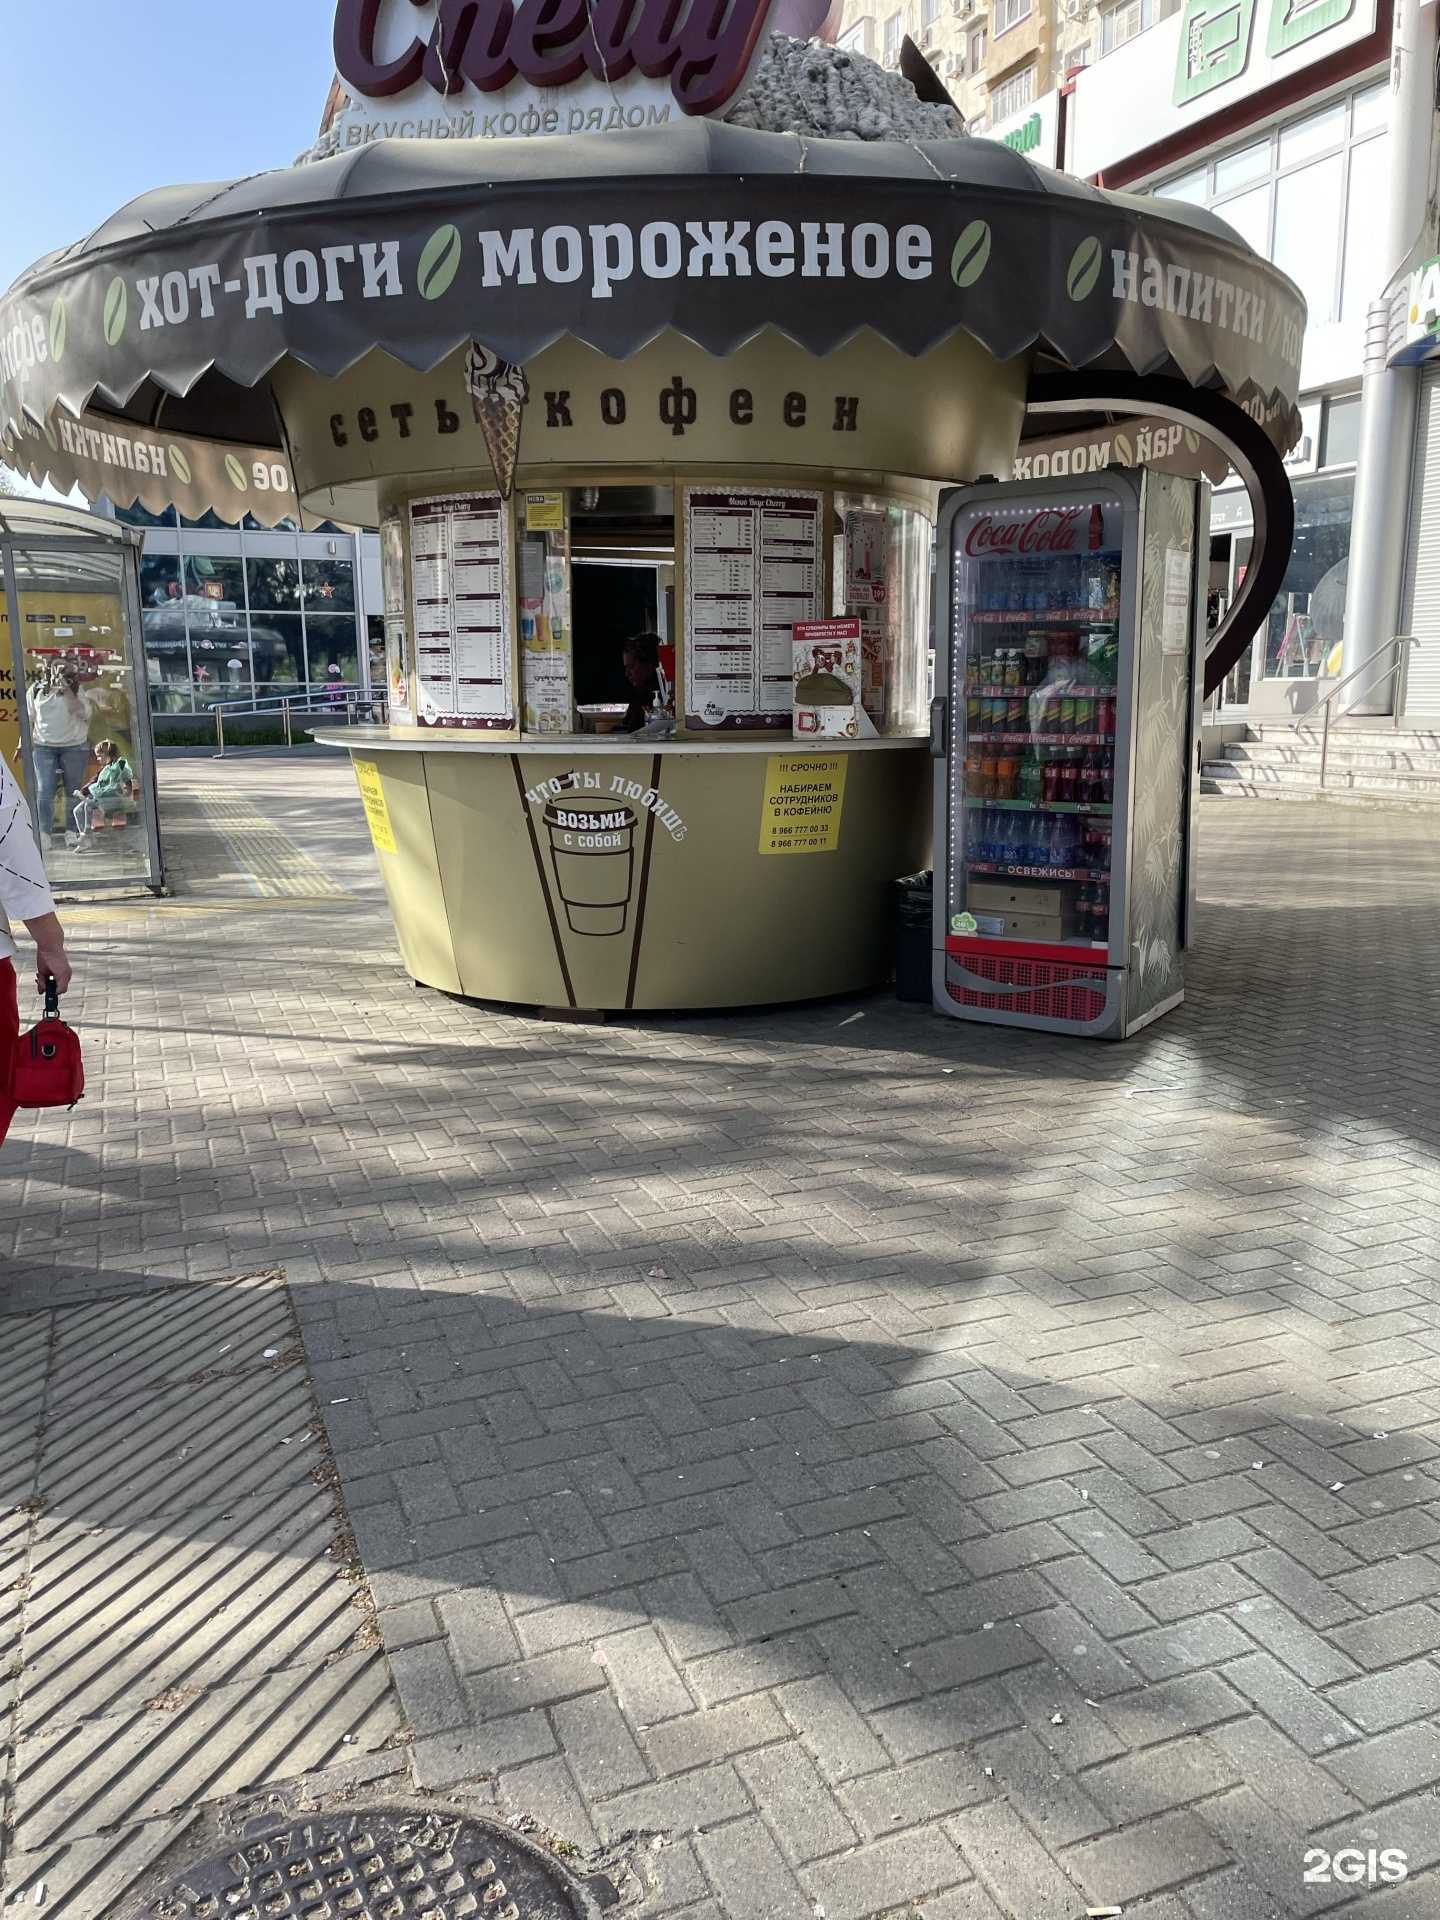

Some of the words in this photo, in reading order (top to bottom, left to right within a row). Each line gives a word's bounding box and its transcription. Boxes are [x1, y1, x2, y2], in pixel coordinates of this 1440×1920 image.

[346, 110, 475, 146] вкусный
[482, 103, 559, 138] кофе
[569, 103, 671, 134] рядом
[478, 220, 933, 298] мороженое
[1111, 249, 1264, 344] напитки
[329, 399, 461, 448] сеть
[543, 376, 860, 436] кофеен
[790, 763, 827, 772] СРОЧНО
[780, 783, 832, 793] НАБИРАЕМ
[769, 794, 838, 806] СОТРУДНИКОВ
[774, 808, 781, 816] В
[783, 805, 832, 816] КОФЕЙНЮ
[578, 832, 622, 848] собой
